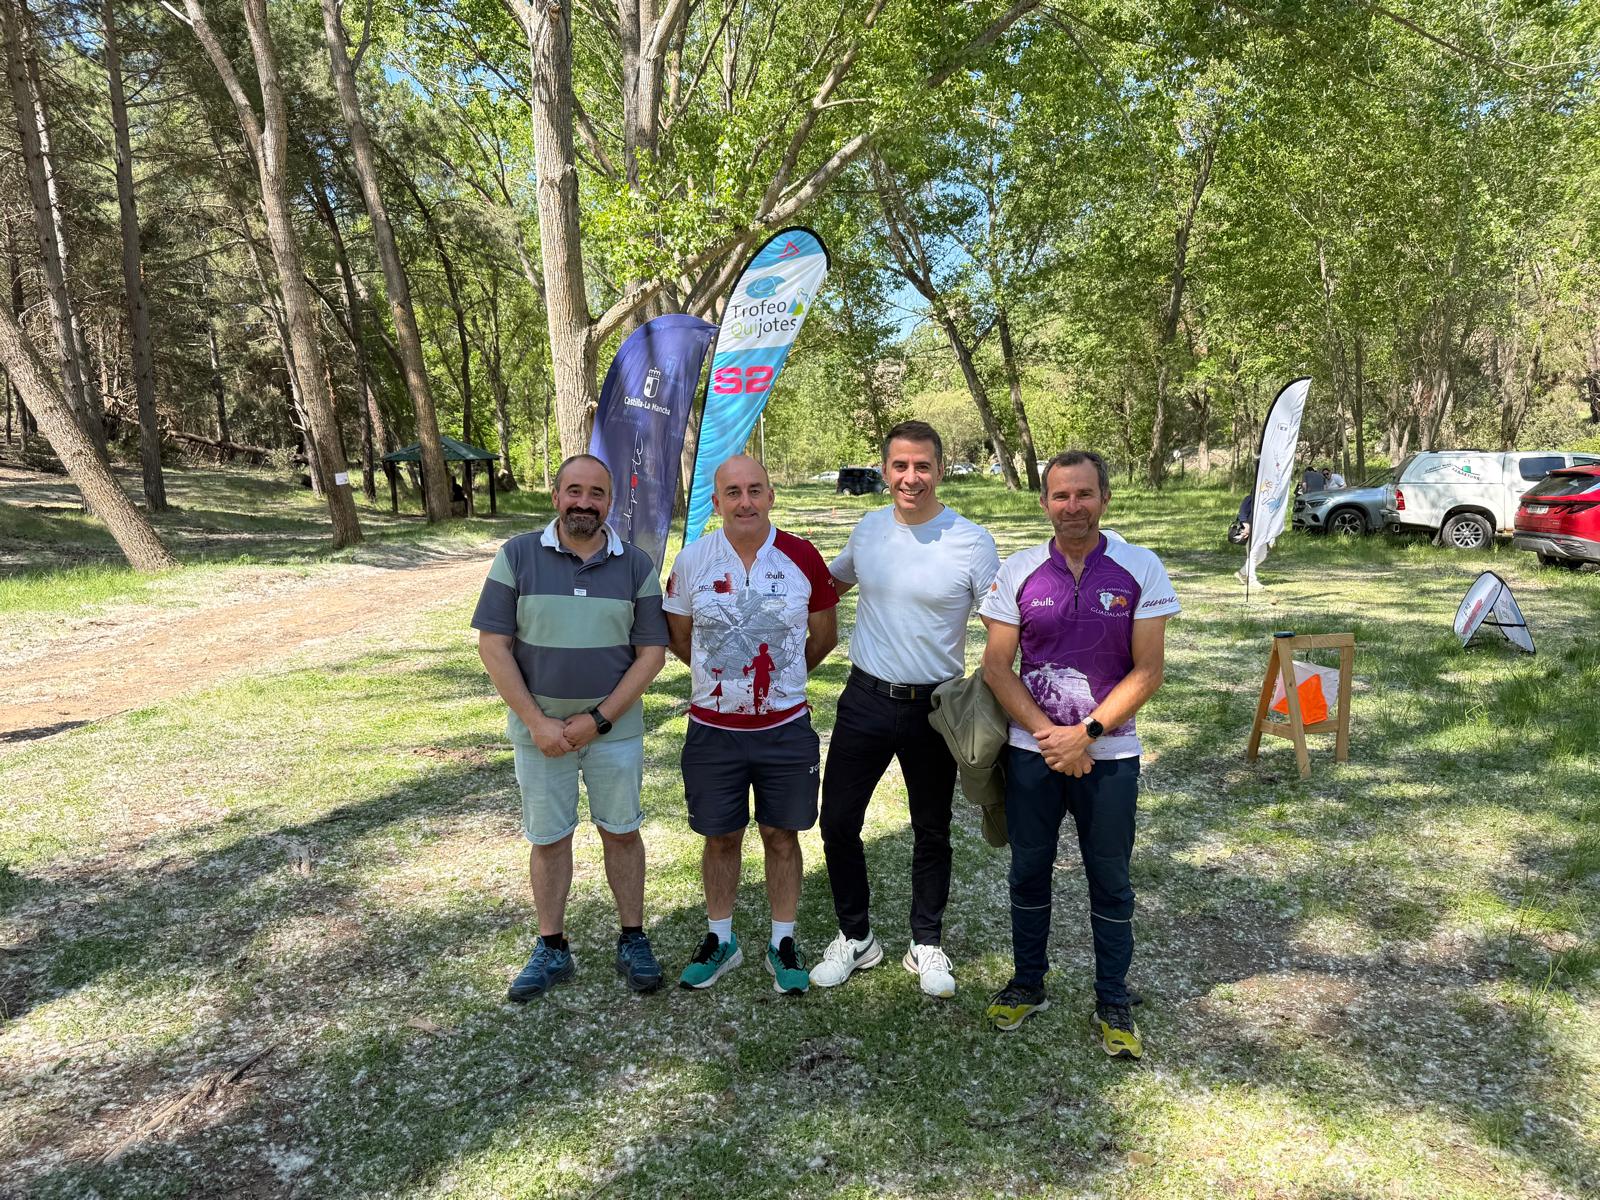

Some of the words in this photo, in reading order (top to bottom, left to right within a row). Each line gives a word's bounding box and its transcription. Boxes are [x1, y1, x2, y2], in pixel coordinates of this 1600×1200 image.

[733, 299, 787, 319] Trofeo
[730, 317, 797, 339] Quijotes
[713, 365, 775, 394] S2
[624, 396, 651, 410] Castilla-La
[651, 402, 671, 415] Mancha
